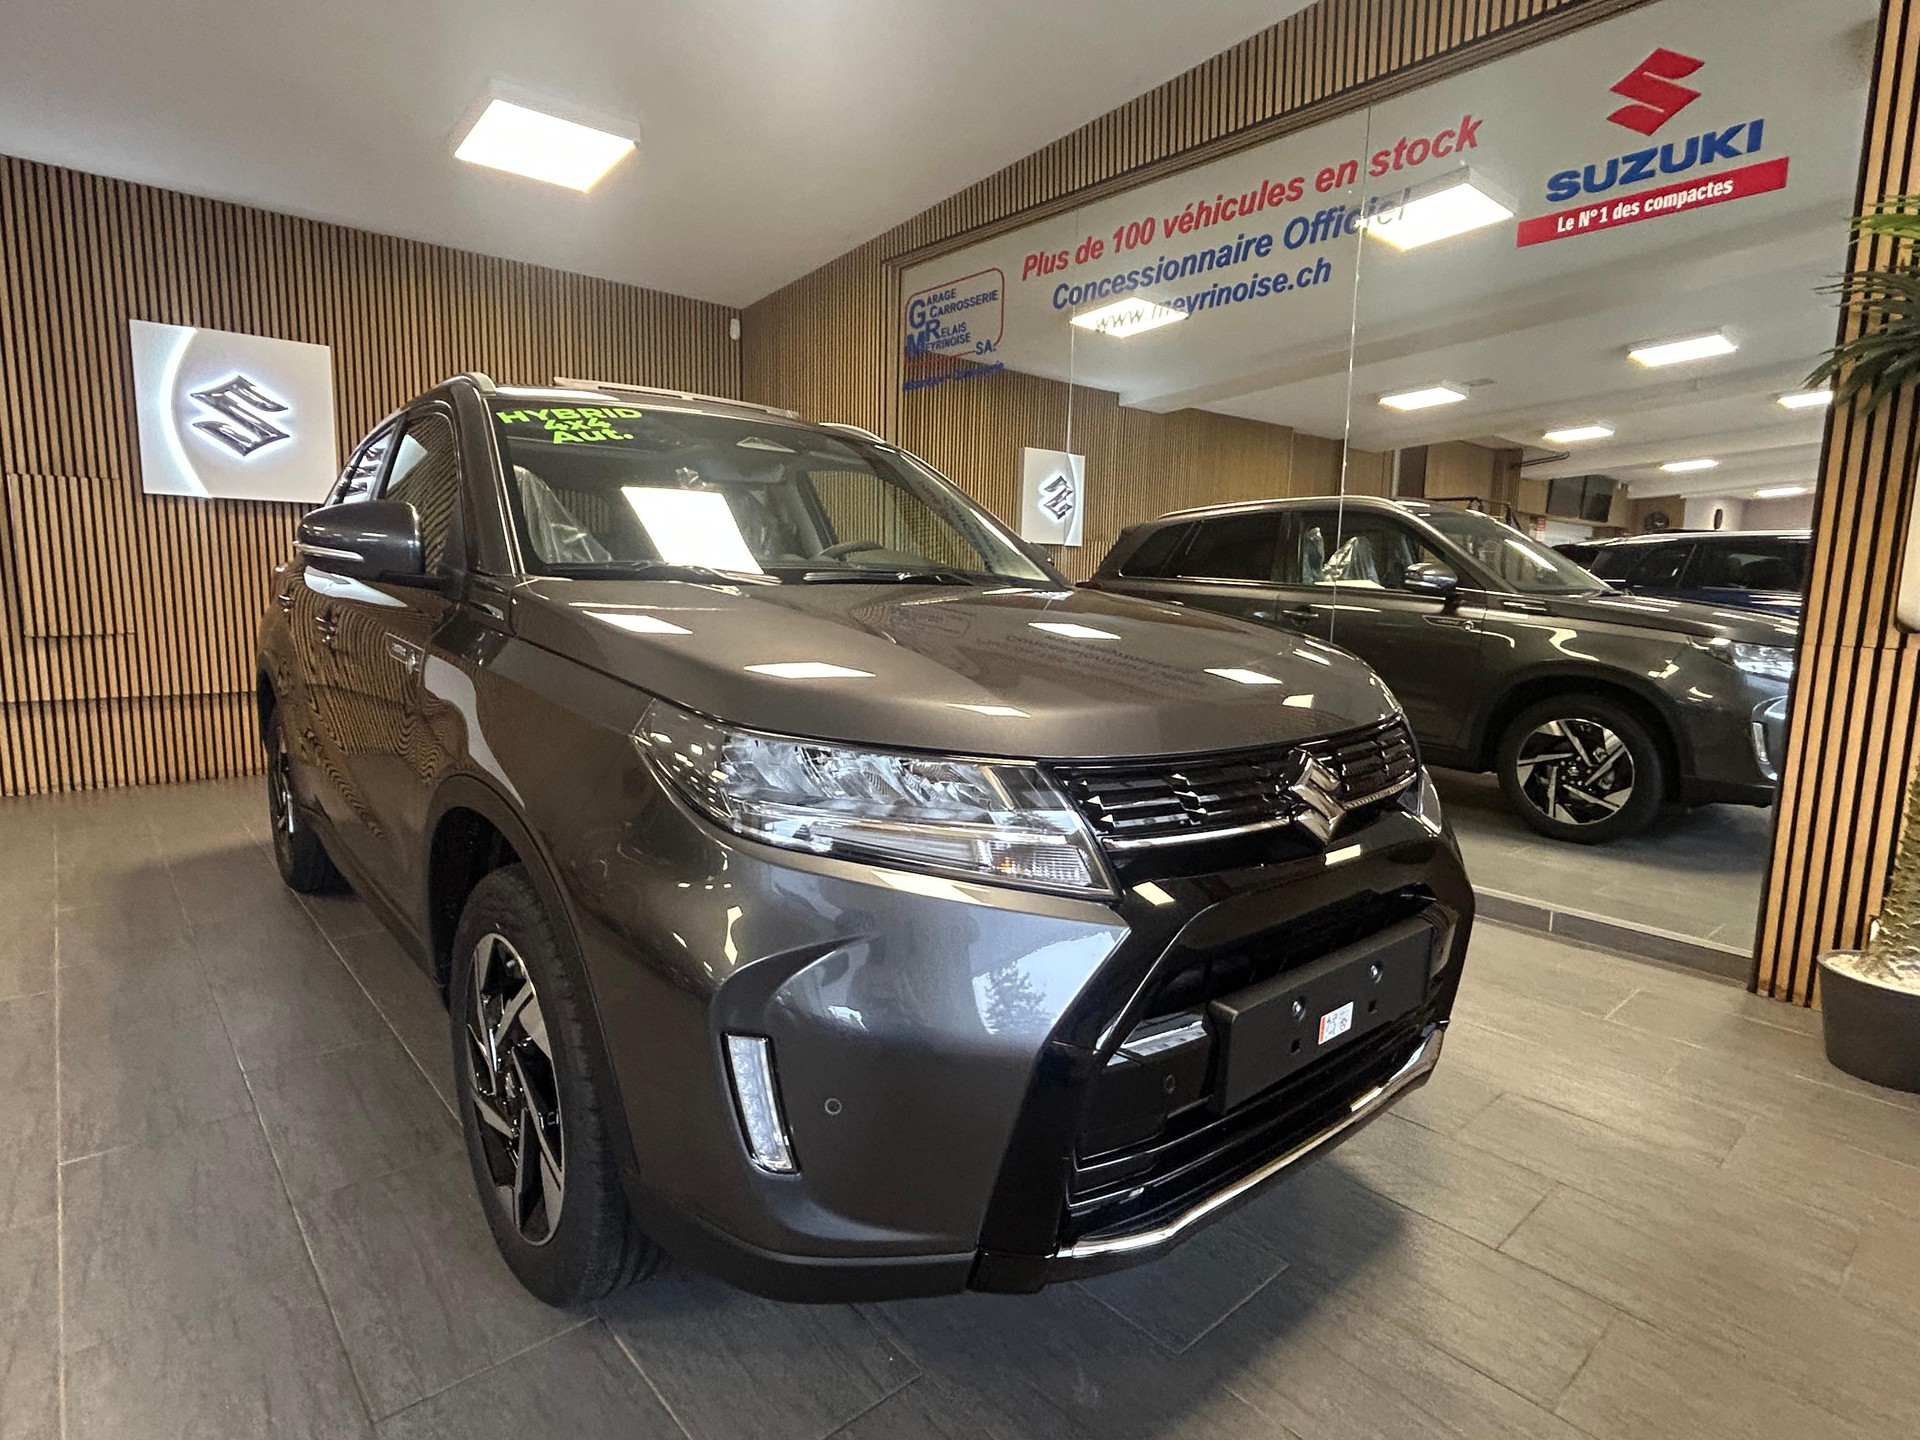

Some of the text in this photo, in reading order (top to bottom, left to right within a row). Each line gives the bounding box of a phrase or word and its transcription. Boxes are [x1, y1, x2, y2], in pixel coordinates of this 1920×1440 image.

[1546, 118, 1764, 202] SUZUKI
[1022, 114, 1483, 281] Plus de 100 véhicules en stock
[1557, 215, 1574, 233] Le
[1612, 200, 1640, 220] des
[1644, 178, 1733, 213] compactes
[1052, 187, 1412, 309] Concessionnaire Officiel
[909, 288, 957, 329] GARAGE
[929, 289, 998, 318] CARROSSERIE
[1095, 257, 1332, 334] wwwmeyrinoise.ch
[925, 319, 967, 342] RELAIS
[496, 408, 642, 424] HYBRID
[544, 417, 611, 430] 4x4
[553, 428, 634, 444] Aut.
